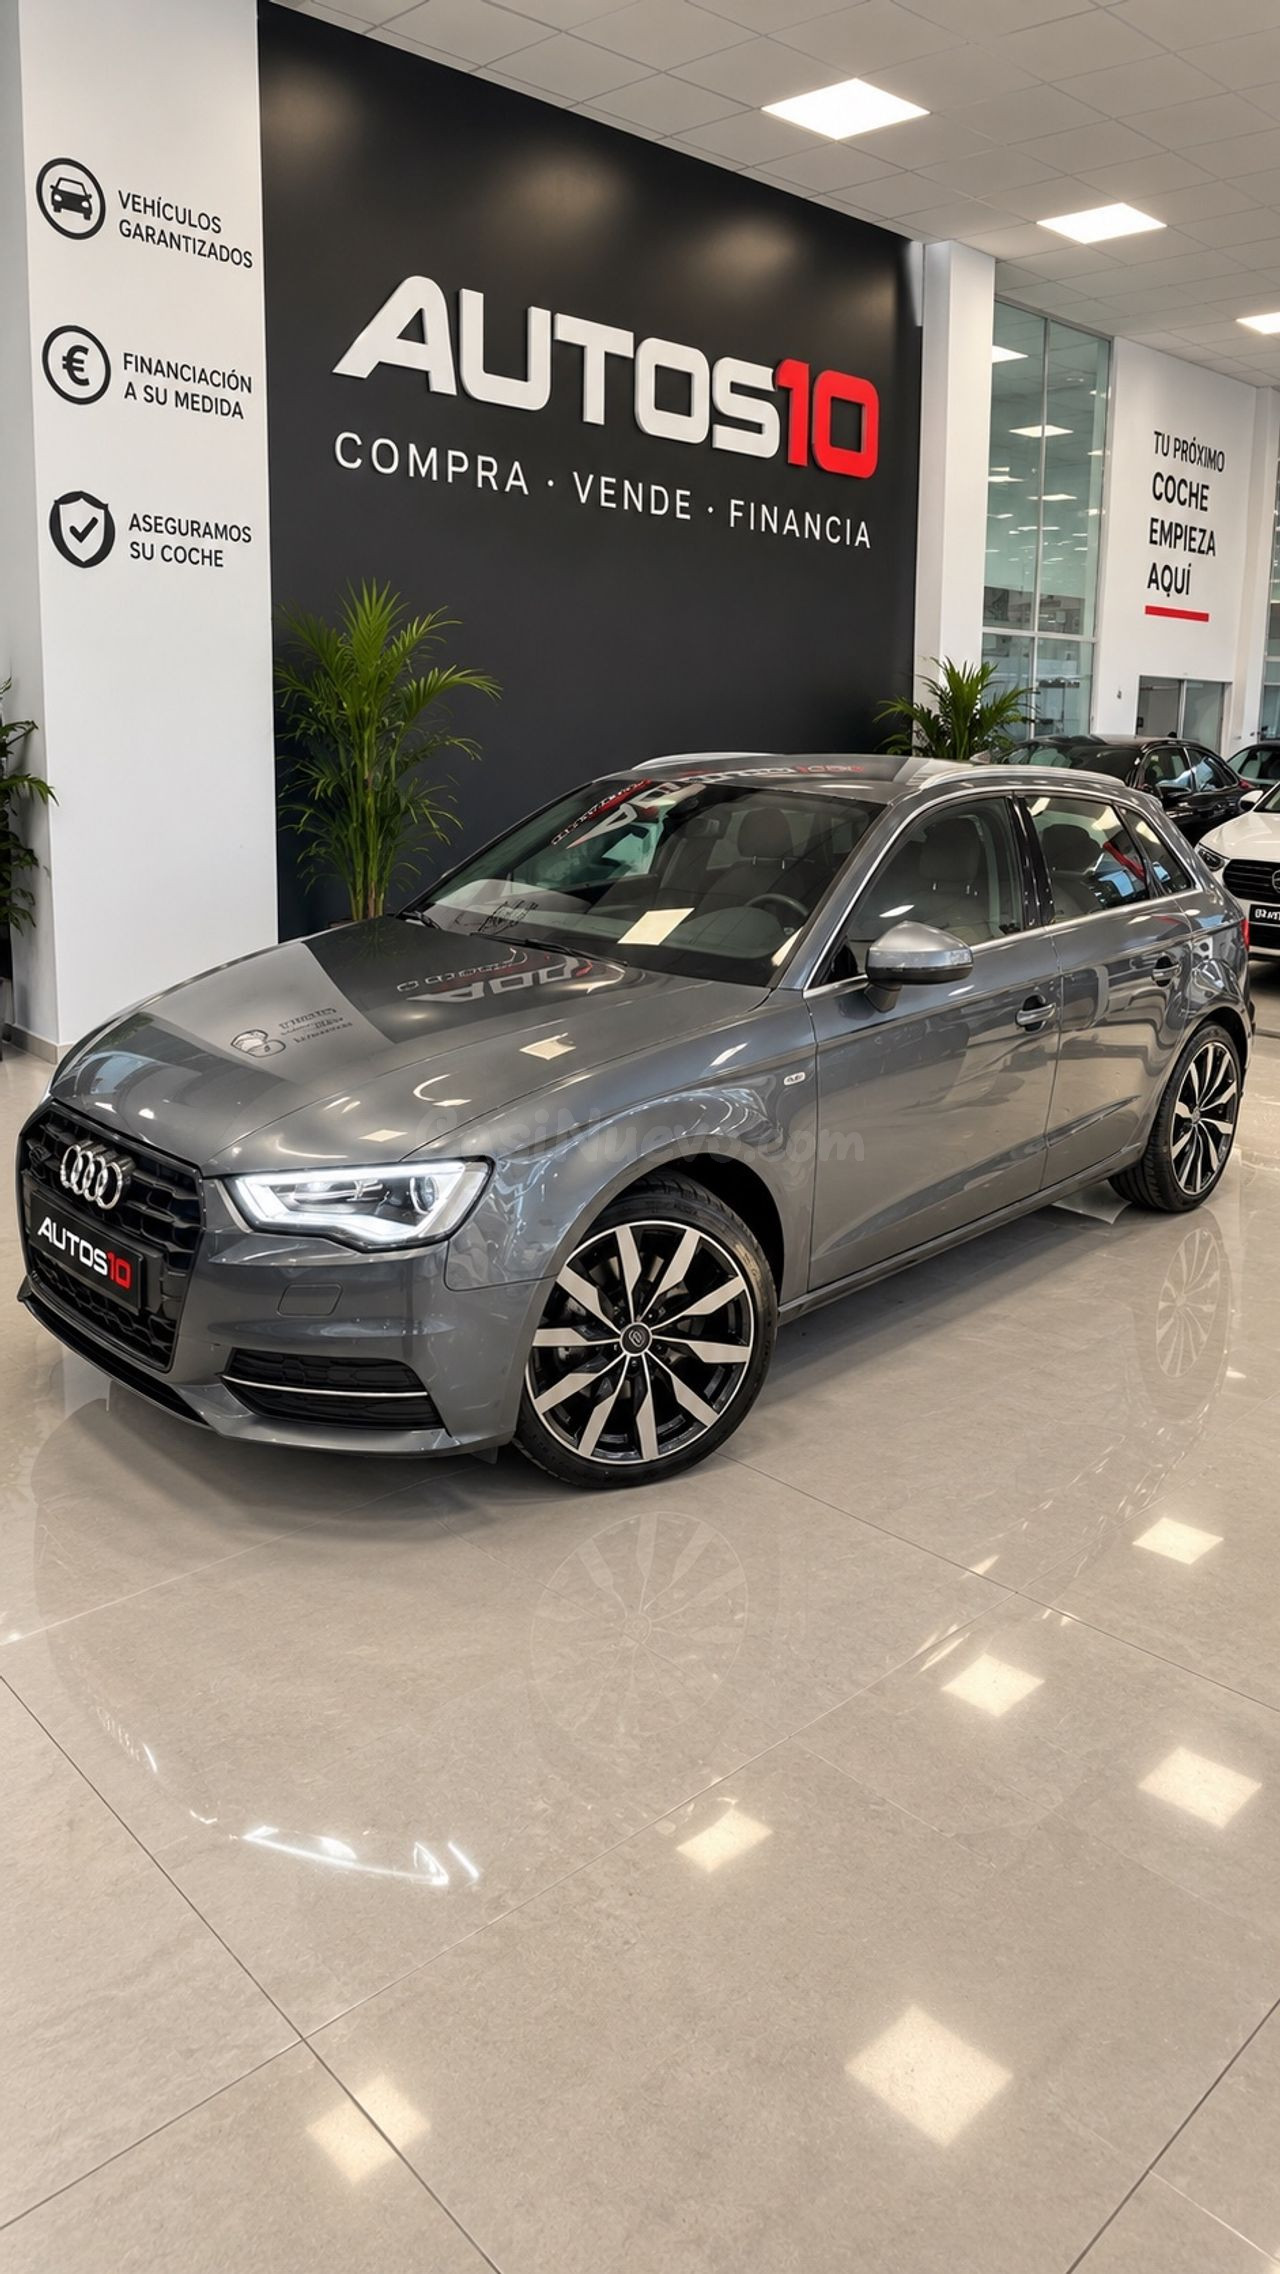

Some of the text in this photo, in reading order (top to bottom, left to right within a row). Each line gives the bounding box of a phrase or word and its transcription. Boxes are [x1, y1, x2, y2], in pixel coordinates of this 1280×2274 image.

[118, 190, 222, 234] VEHÍCULOS
[118, 219, 253, 269] GARANTIZADOS
[123, 352, 252, 394] FINANCIACIÓN
[332, 275, 880, 479] AUTOS10
[124, 384, 244, 420] A SU MEDIDA
[1153, 430, 1225, 472] TU PRÓXIMO
[334, 431, 871, 548] COMPRA VENDE FINANCIA
[1152, 471, 1209, 511] COCHE
[129, 513, 252, 543] ASEGURAMOS
[1149, 517, 1216, 556] EMPIEZA
[129, 541, 224, 568] SU COCHE
[1147, 562, 1191, 597] AQUÍ
[37, 1216, 132, 1289] AUTOS10
